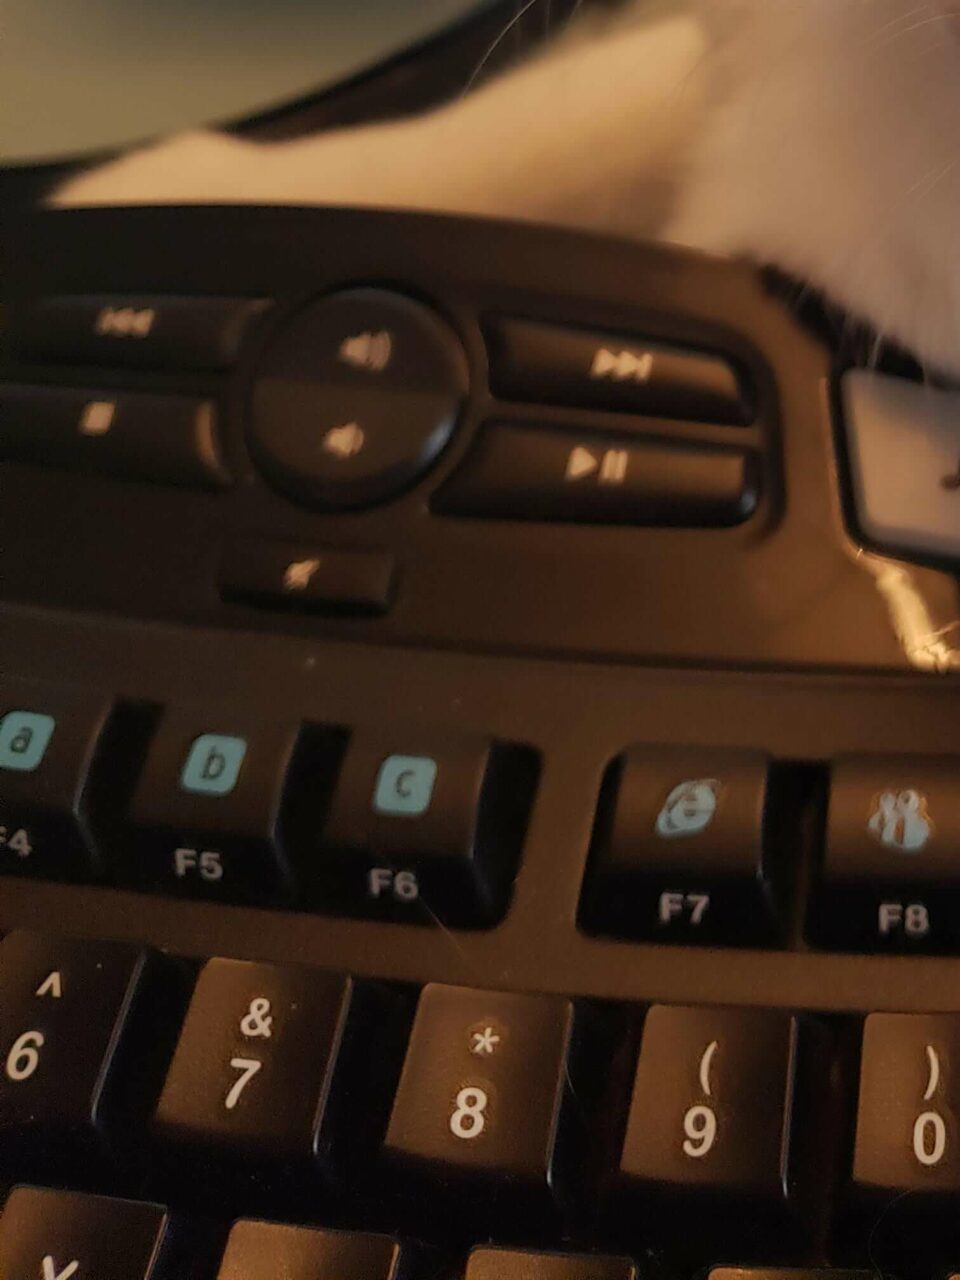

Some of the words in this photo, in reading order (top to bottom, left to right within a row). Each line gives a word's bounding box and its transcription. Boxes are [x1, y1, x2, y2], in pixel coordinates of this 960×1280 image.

[201, 745, 227, 780] b
[174, 848, 223, 880] F5
[369, 868, 419, 900] F6
[659, 892, 710, 923] F7
[878, 903, 930, 936] F8
[240, 997, 273, 1038] &
[6, 1030, 45, 1081] 6
[224, 1057, 262, 1110] 7
[449, 1086, 488, 1139] 8
[682, 1105, 717, 1158] 9
